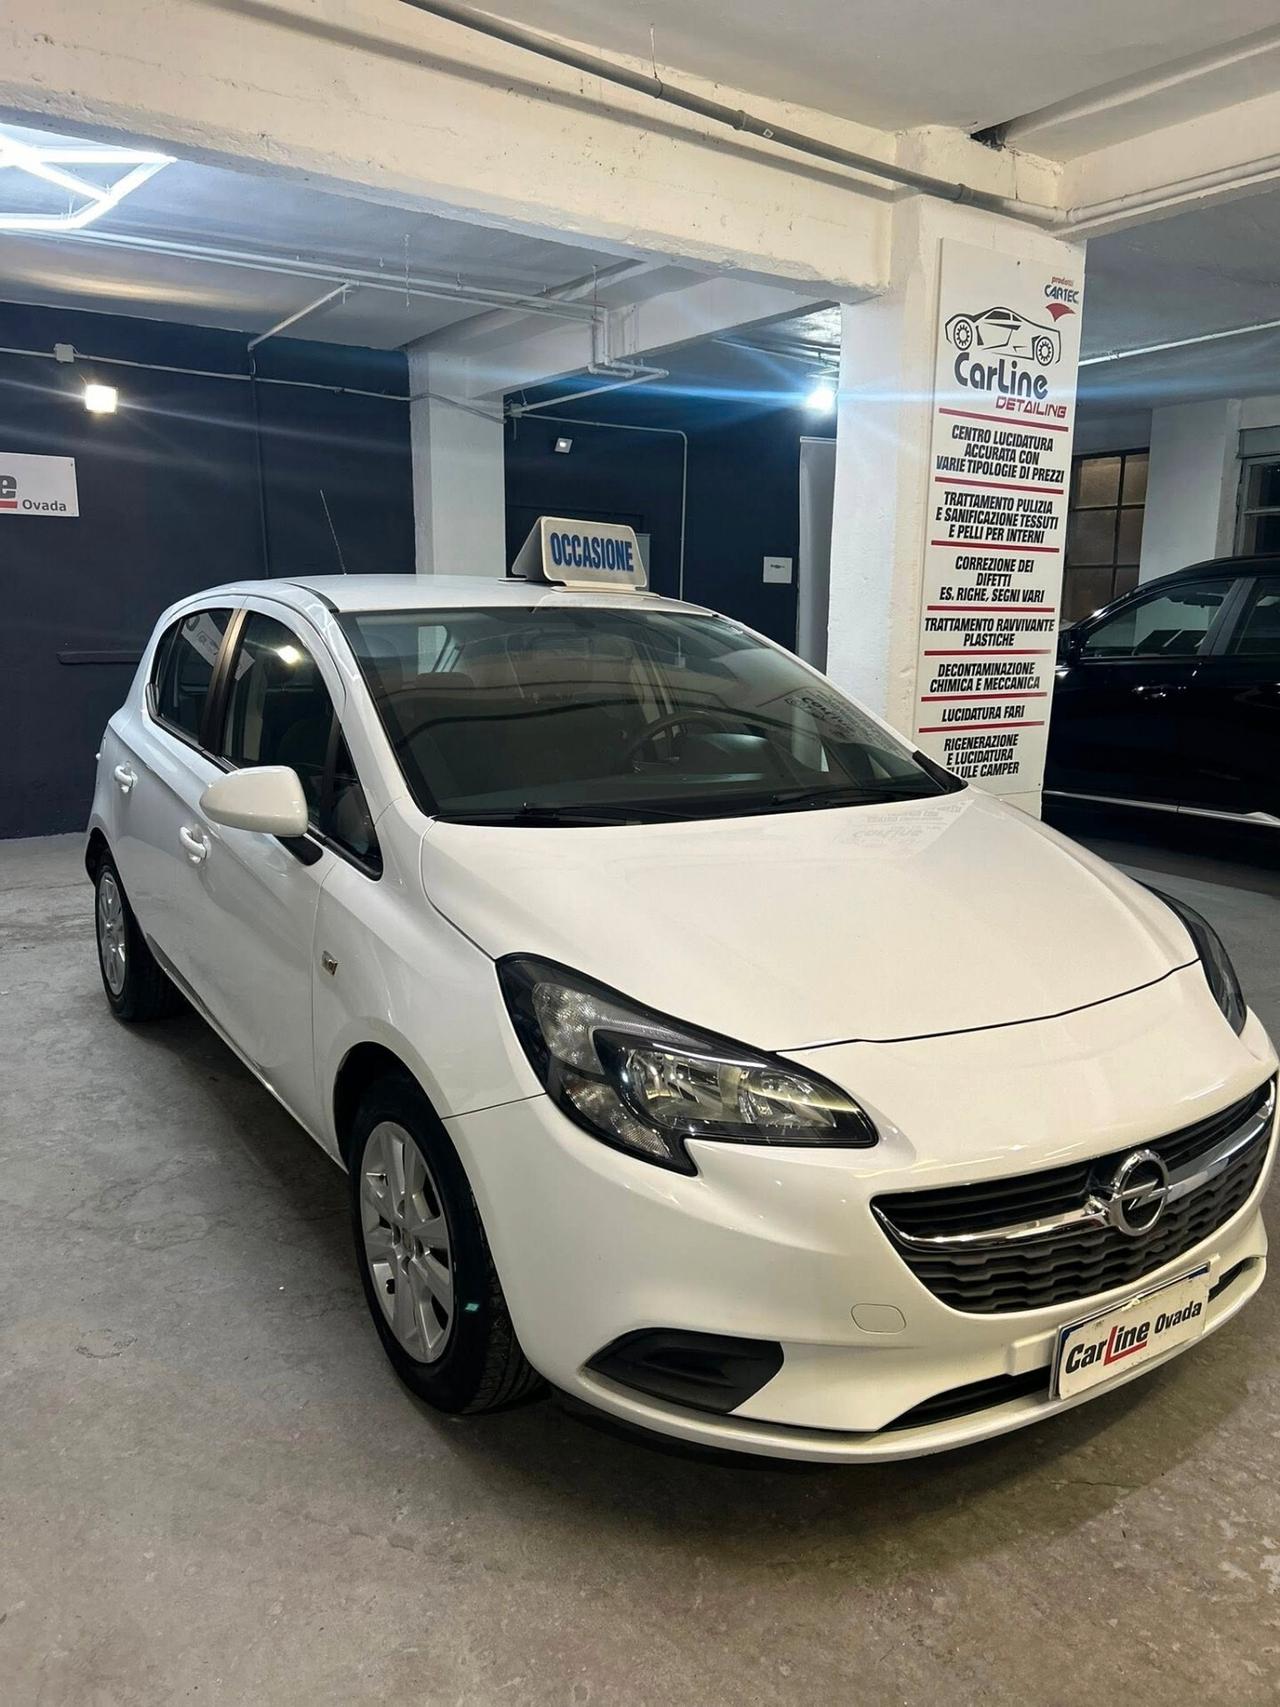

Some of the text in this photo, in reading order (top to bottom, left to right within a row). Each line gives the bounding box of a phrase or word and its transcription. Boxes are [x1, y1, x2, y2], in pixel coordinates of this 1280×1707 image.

[1044, 284, 1080, 304] CARTEC
[954, 352, 1048, 400] CarLine
[995, 396, 1067, 419] DETAILING
[951, 424, 1053, 452] CENTRO LUCIDATURA
[964, 443, 1040, 465] ACCURATA CON
[936, 455, 1064, 484] VARIE TIPOLOGIE DI PREZZI
[22, 499, 67, 512] Ovada
[944, 491, 1053, 514] TRATTAMENTO PULIZIA
[935, 507, 1059, 530] E SANIFICAZIONE TESSUTI
[948, 525, 1044, 544] E PELLI PER INTERNI
[550, 532, 634, 572] OCCASIONE
[955, 556, 1034, 573] CORREZIONE DEI
[976, 573, 1011, 587] DIFETTI
[939, 587, 1044, 603] ES. RIGHE, SEGNI VARI
[925, 618, 1055, 632] TRATTAMENTO RAVVIVANTE
[963, 633, 1015, 647] PLASTICHE
[938, 662, 1036, 678] DECONTAMINAZIONE
[930, 676, 1040, 693] CHIMICA E MECCANICA
[942, 705, 1025, 722] LUCIDATURA FARI
[944, 734, 1019, 751] RIGENERAZIONE
[946, 748, 1014, 766] E LUCIDATURA
[980, 762, 1020, 777] CAMPER
[1065, 1301, 1203, 1375] CarLine Ovada
